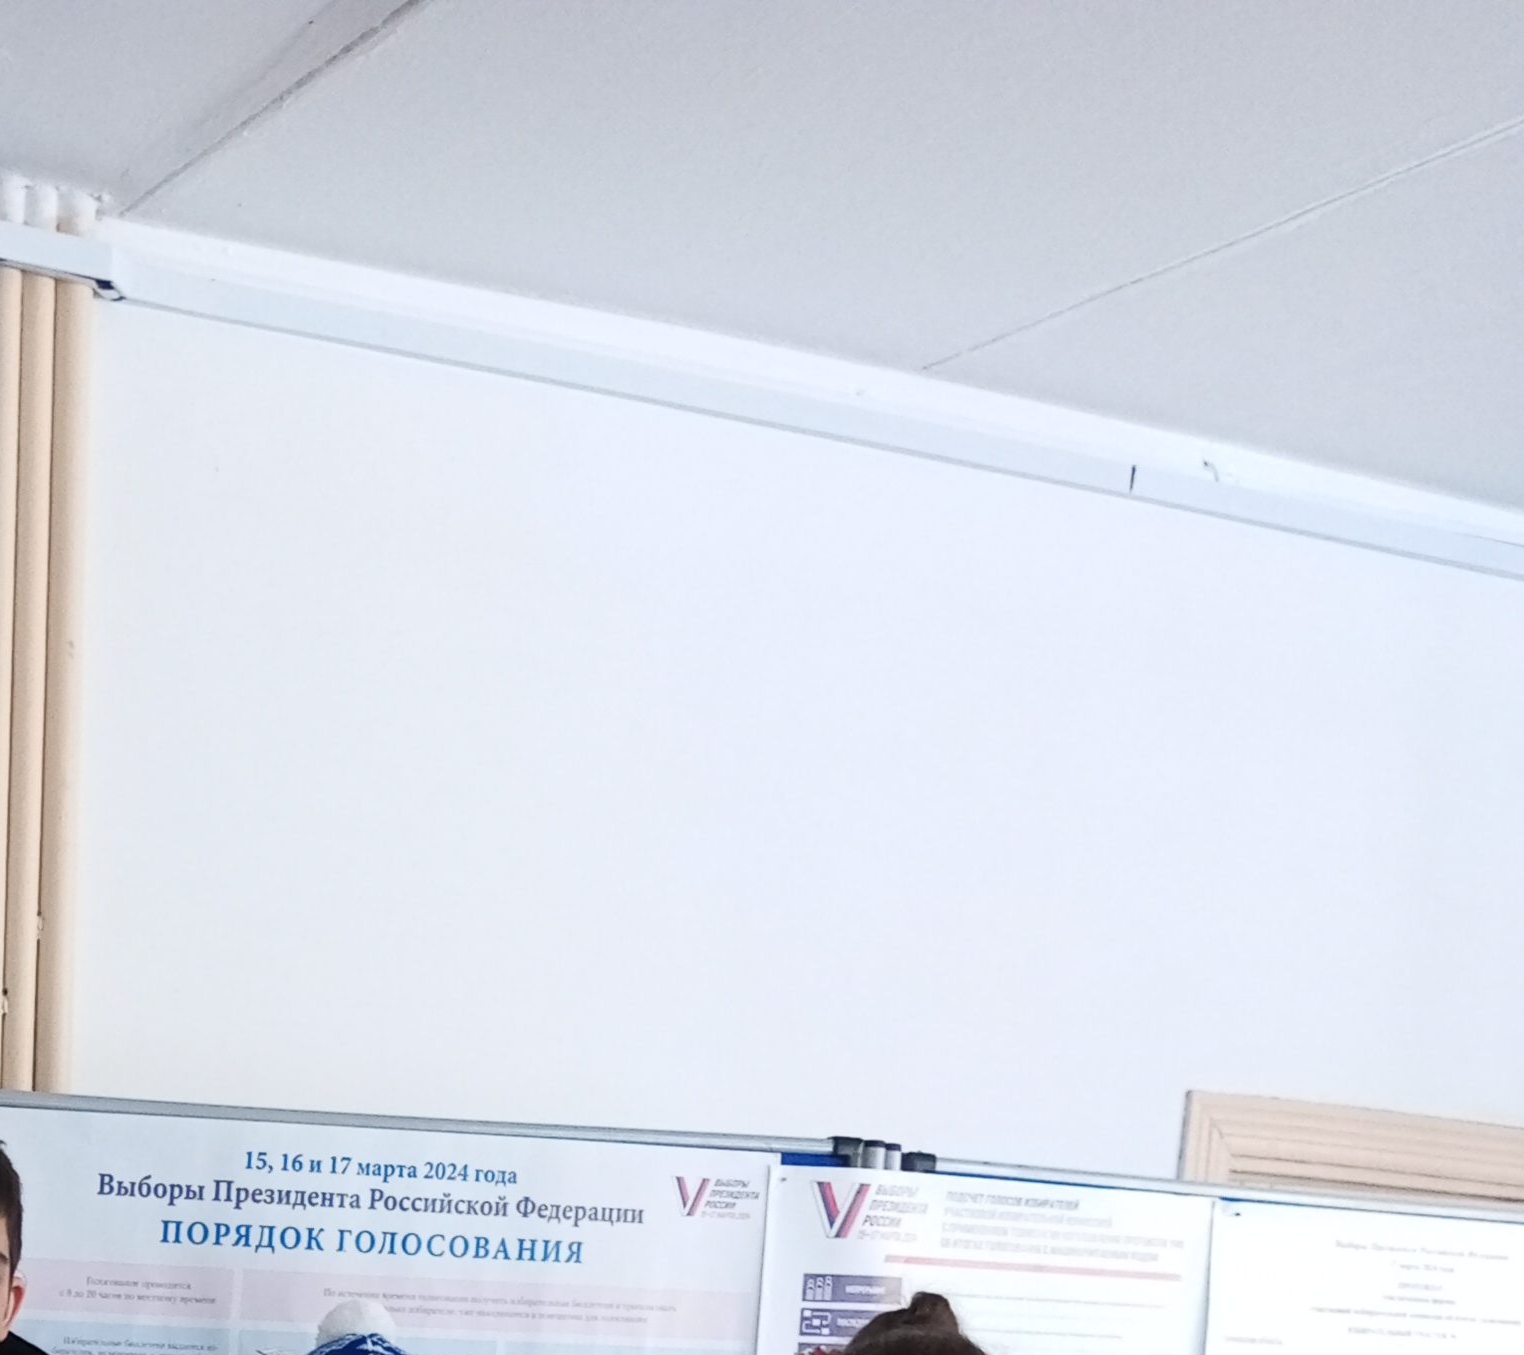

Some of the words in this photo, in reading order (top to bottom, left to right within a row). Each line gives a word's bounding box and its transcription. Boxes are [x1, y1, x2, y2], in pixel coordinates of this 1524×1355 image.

[244, 1150, 274, 1173] 15,
[280, 1153, 304, 1173] 16
[309, 1159, 322, 1173] и
[329, 1156, 352, 1175] 17
[357, 1160, 418, 1183] марта
[423, 1161, 469, 1182] 2024
[474, 1167, 518, 1186] года
[97, 1173, 205, 1207] Выборы
[211, 1180, 362, 1210] Президента
[368, 1188, 509, 1218] Российской
[516, 1195, 645, 1228] Федерации
[160, 1219, 325, 1254] ПОРЯДОК
[336, 1229, 584, 1264] ГОЛОСОВАНИЯ
